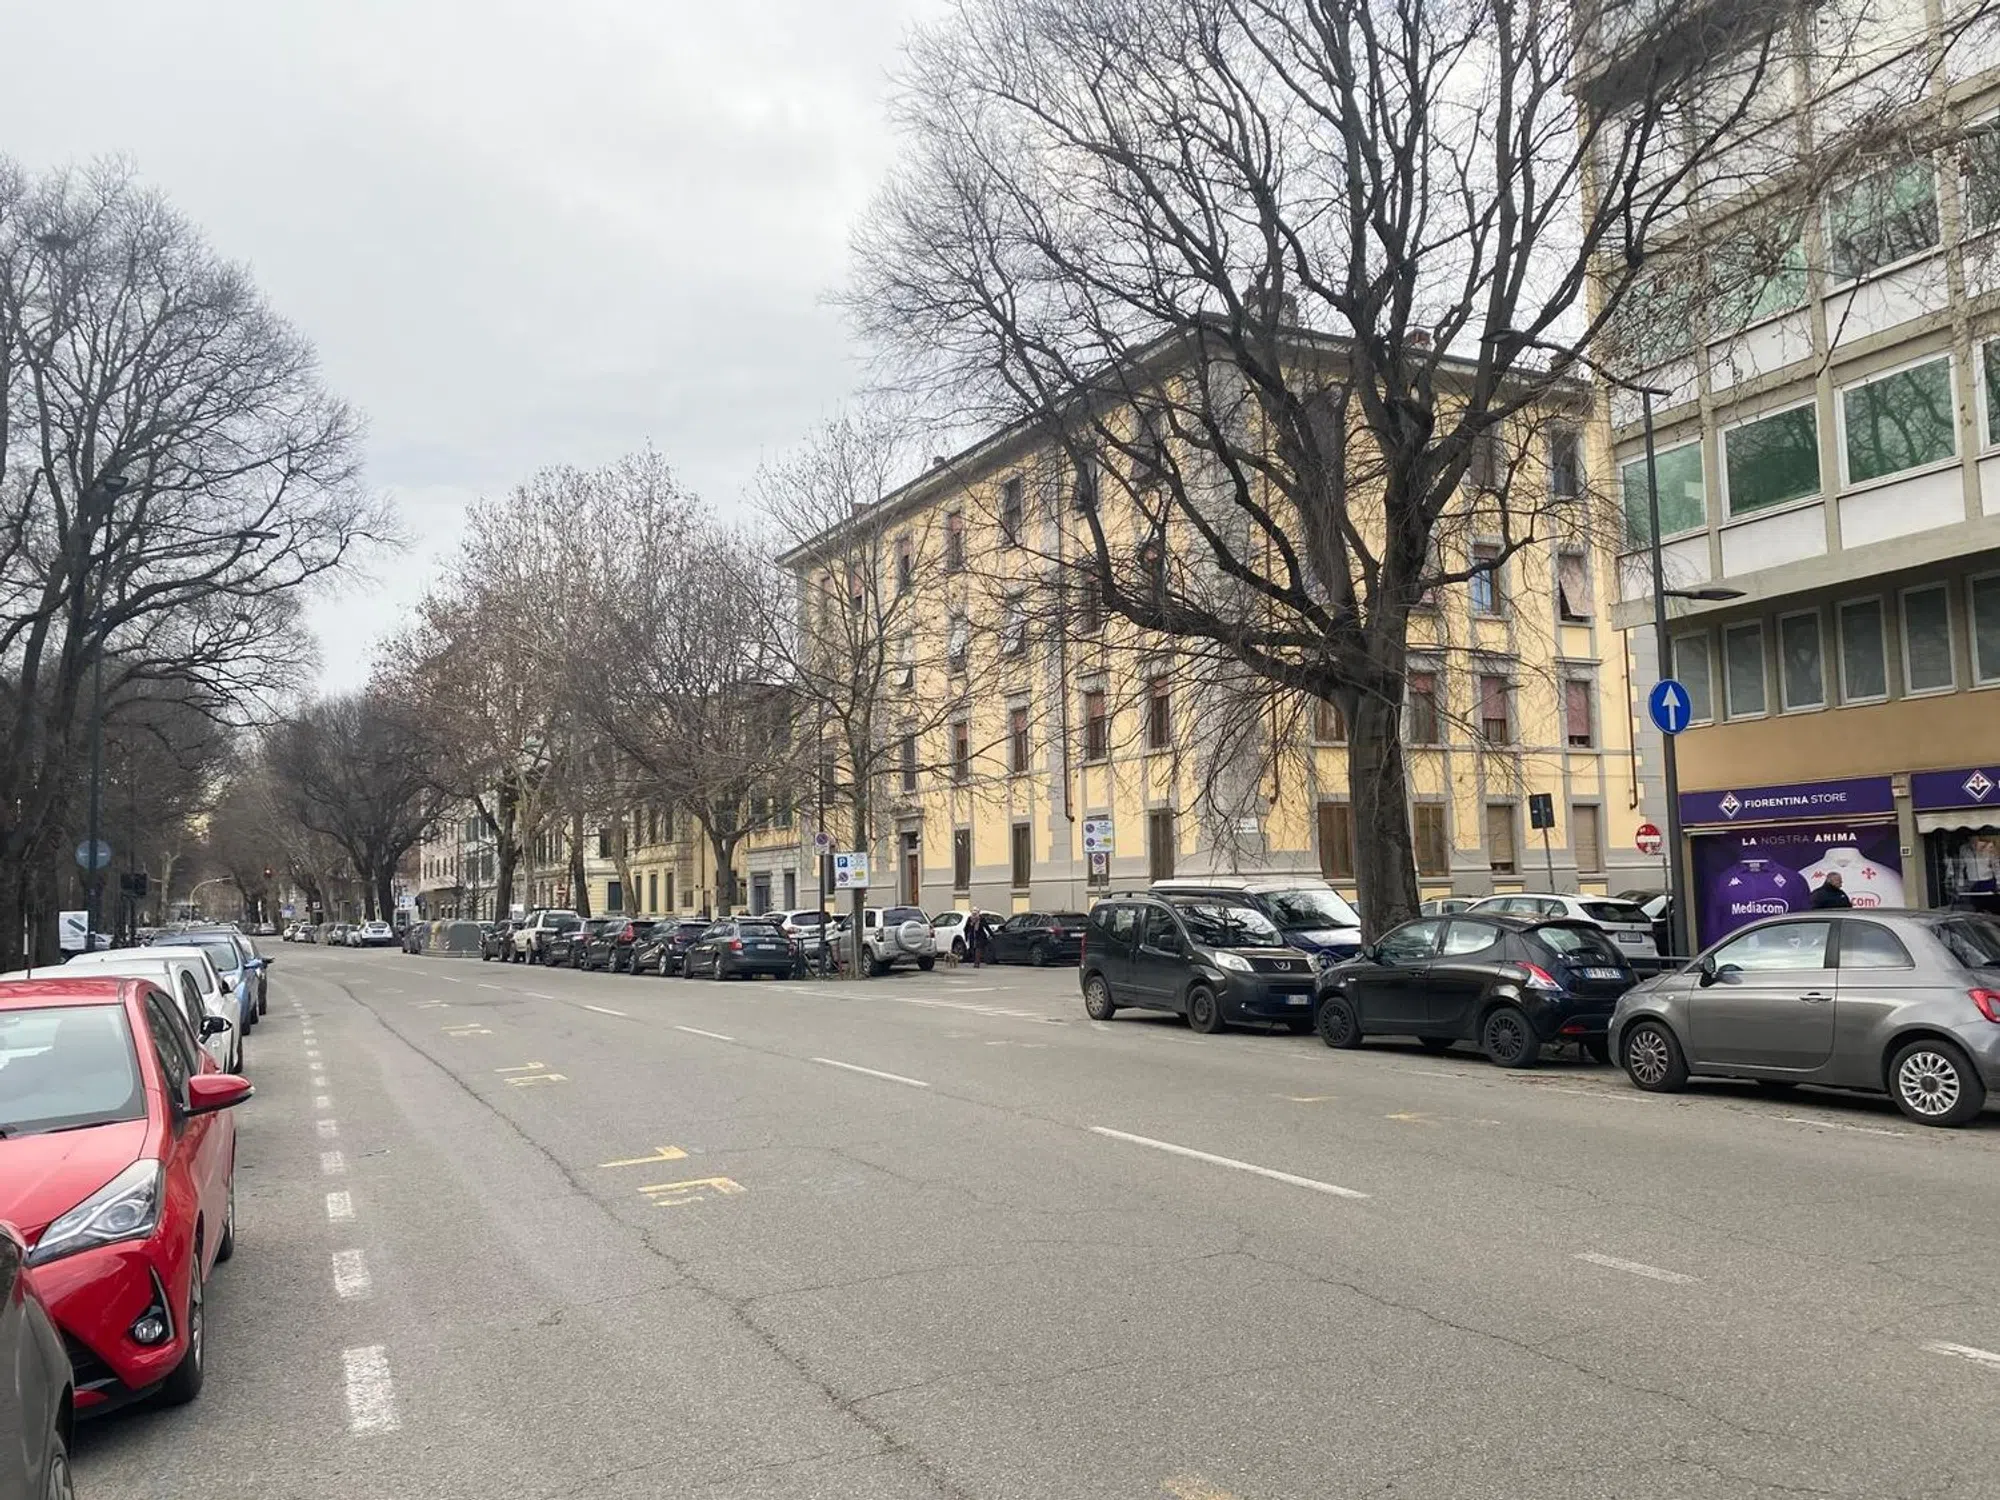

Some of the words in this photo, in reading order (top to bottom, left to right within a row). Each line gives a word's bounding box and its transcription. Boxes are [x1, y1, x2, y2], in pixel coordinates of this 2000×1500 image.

[1744, 796, 1809, 808] FIORENTINA
[1811, 792, 1847, 804] STORE
[1742, 837, 1757, 846] LA
[1761, 834, 1810, 846] NOSTRA
[1814, 832, 1857, 843] ANIMA
[1731, 901, 1784, 915] Mediacom
